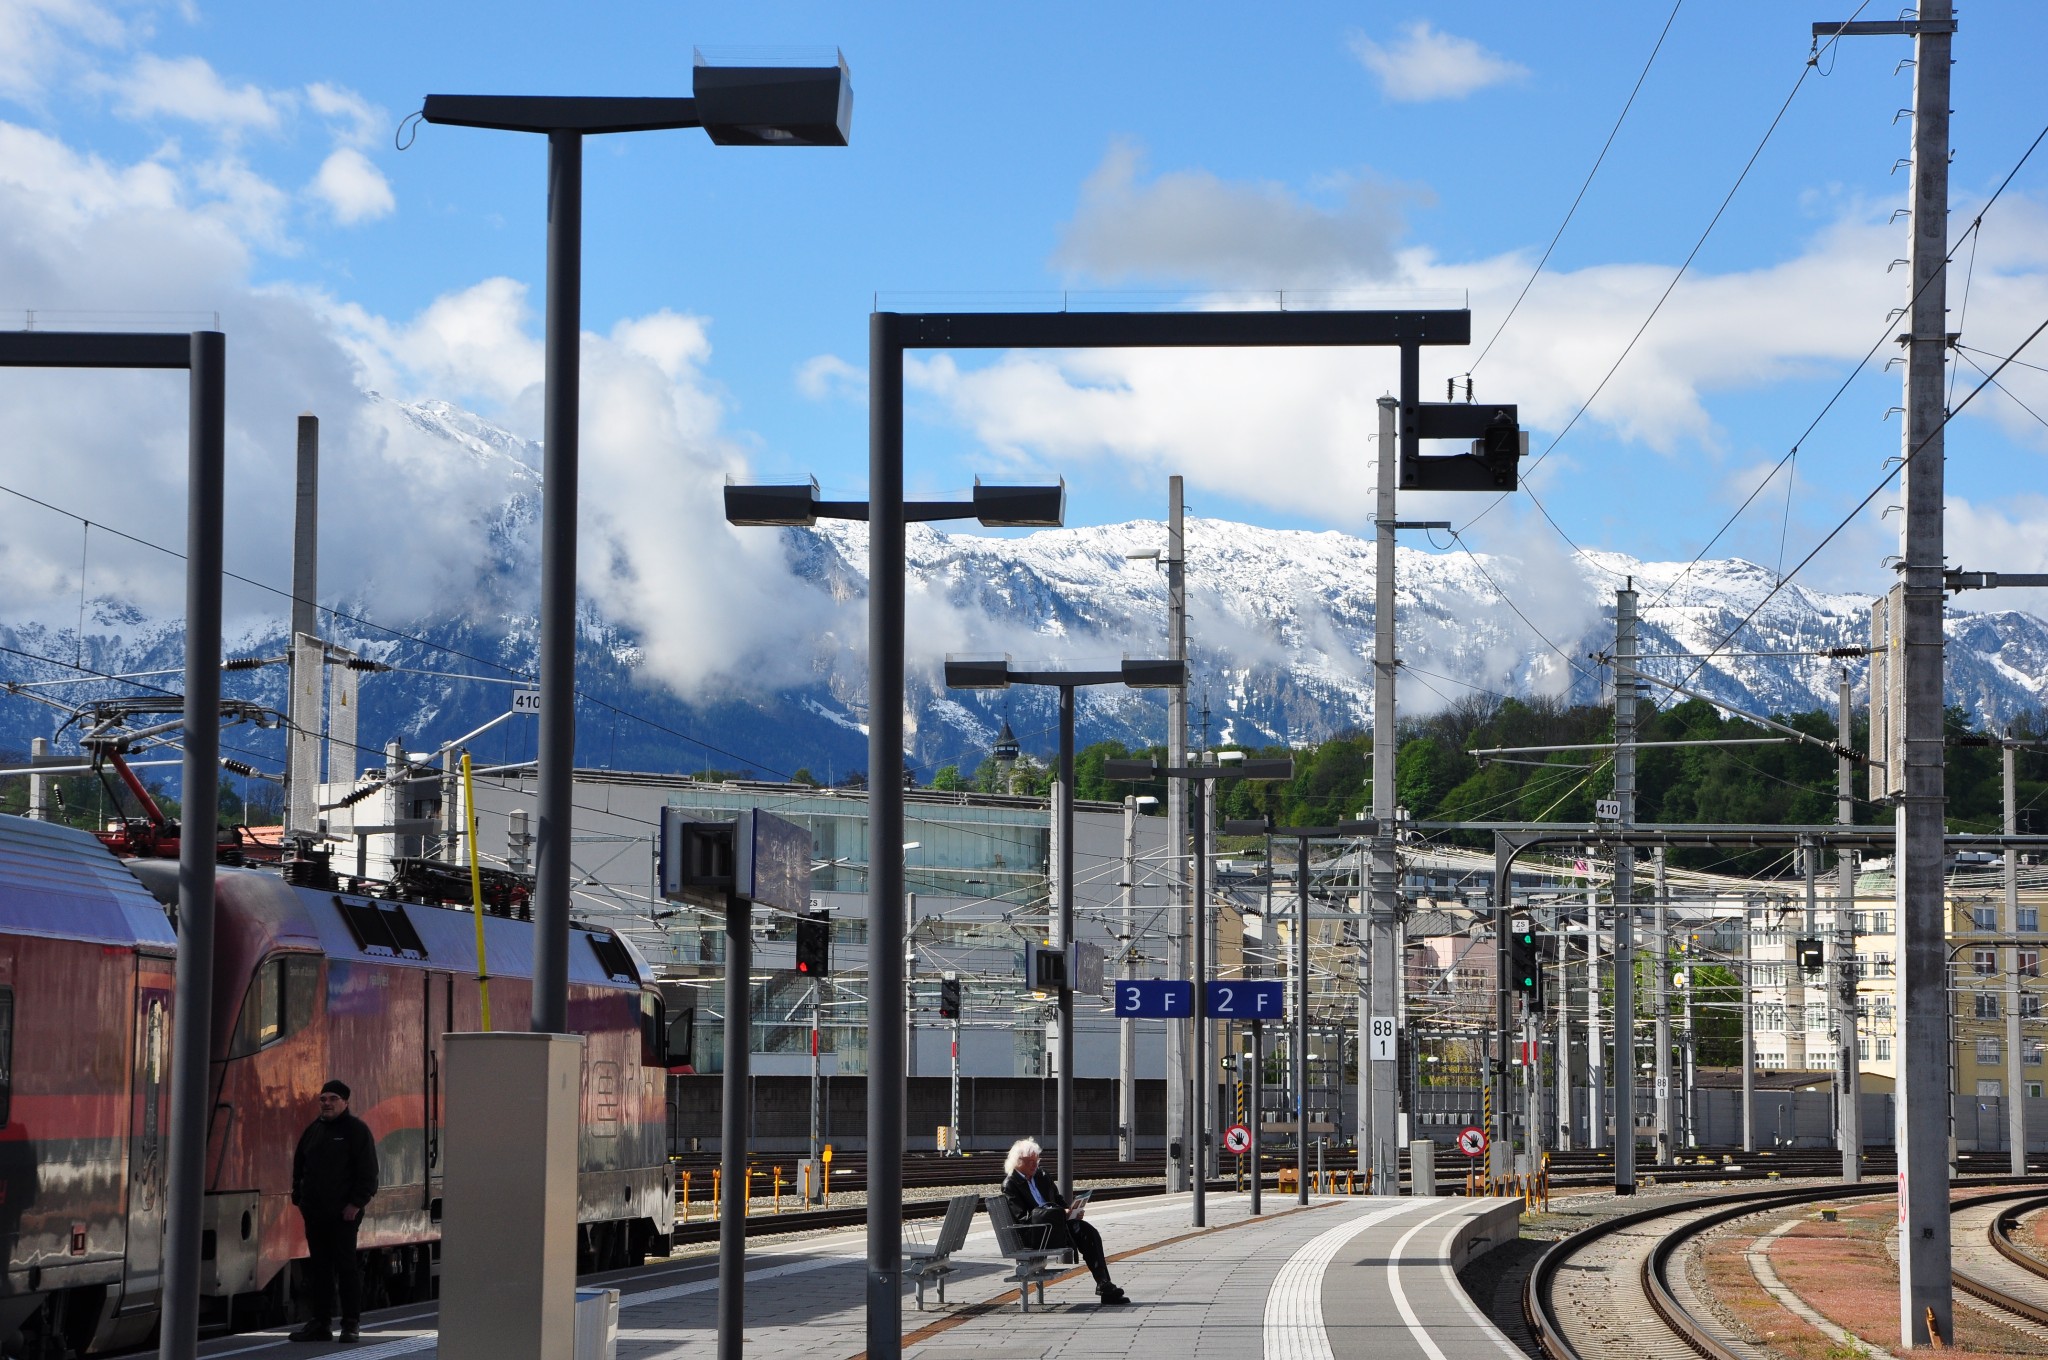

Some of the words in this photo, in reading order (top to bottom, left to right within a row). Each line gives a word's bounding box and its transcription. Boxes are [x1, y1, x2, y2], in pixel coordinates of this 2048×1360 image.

[515, 695, 540, 709] 410
[1598, 804, 1618, 815] 410
[1125, 987, 1141, 1011] 3
[1164, 993, 1176, 1011] F
[1218, 988, 1234, 1012] 2
[1257, 994, 1268, 1012] F
[1374, 1020, 1392, 1037] 88
[1380, 1040, 1386, 1056] 1
